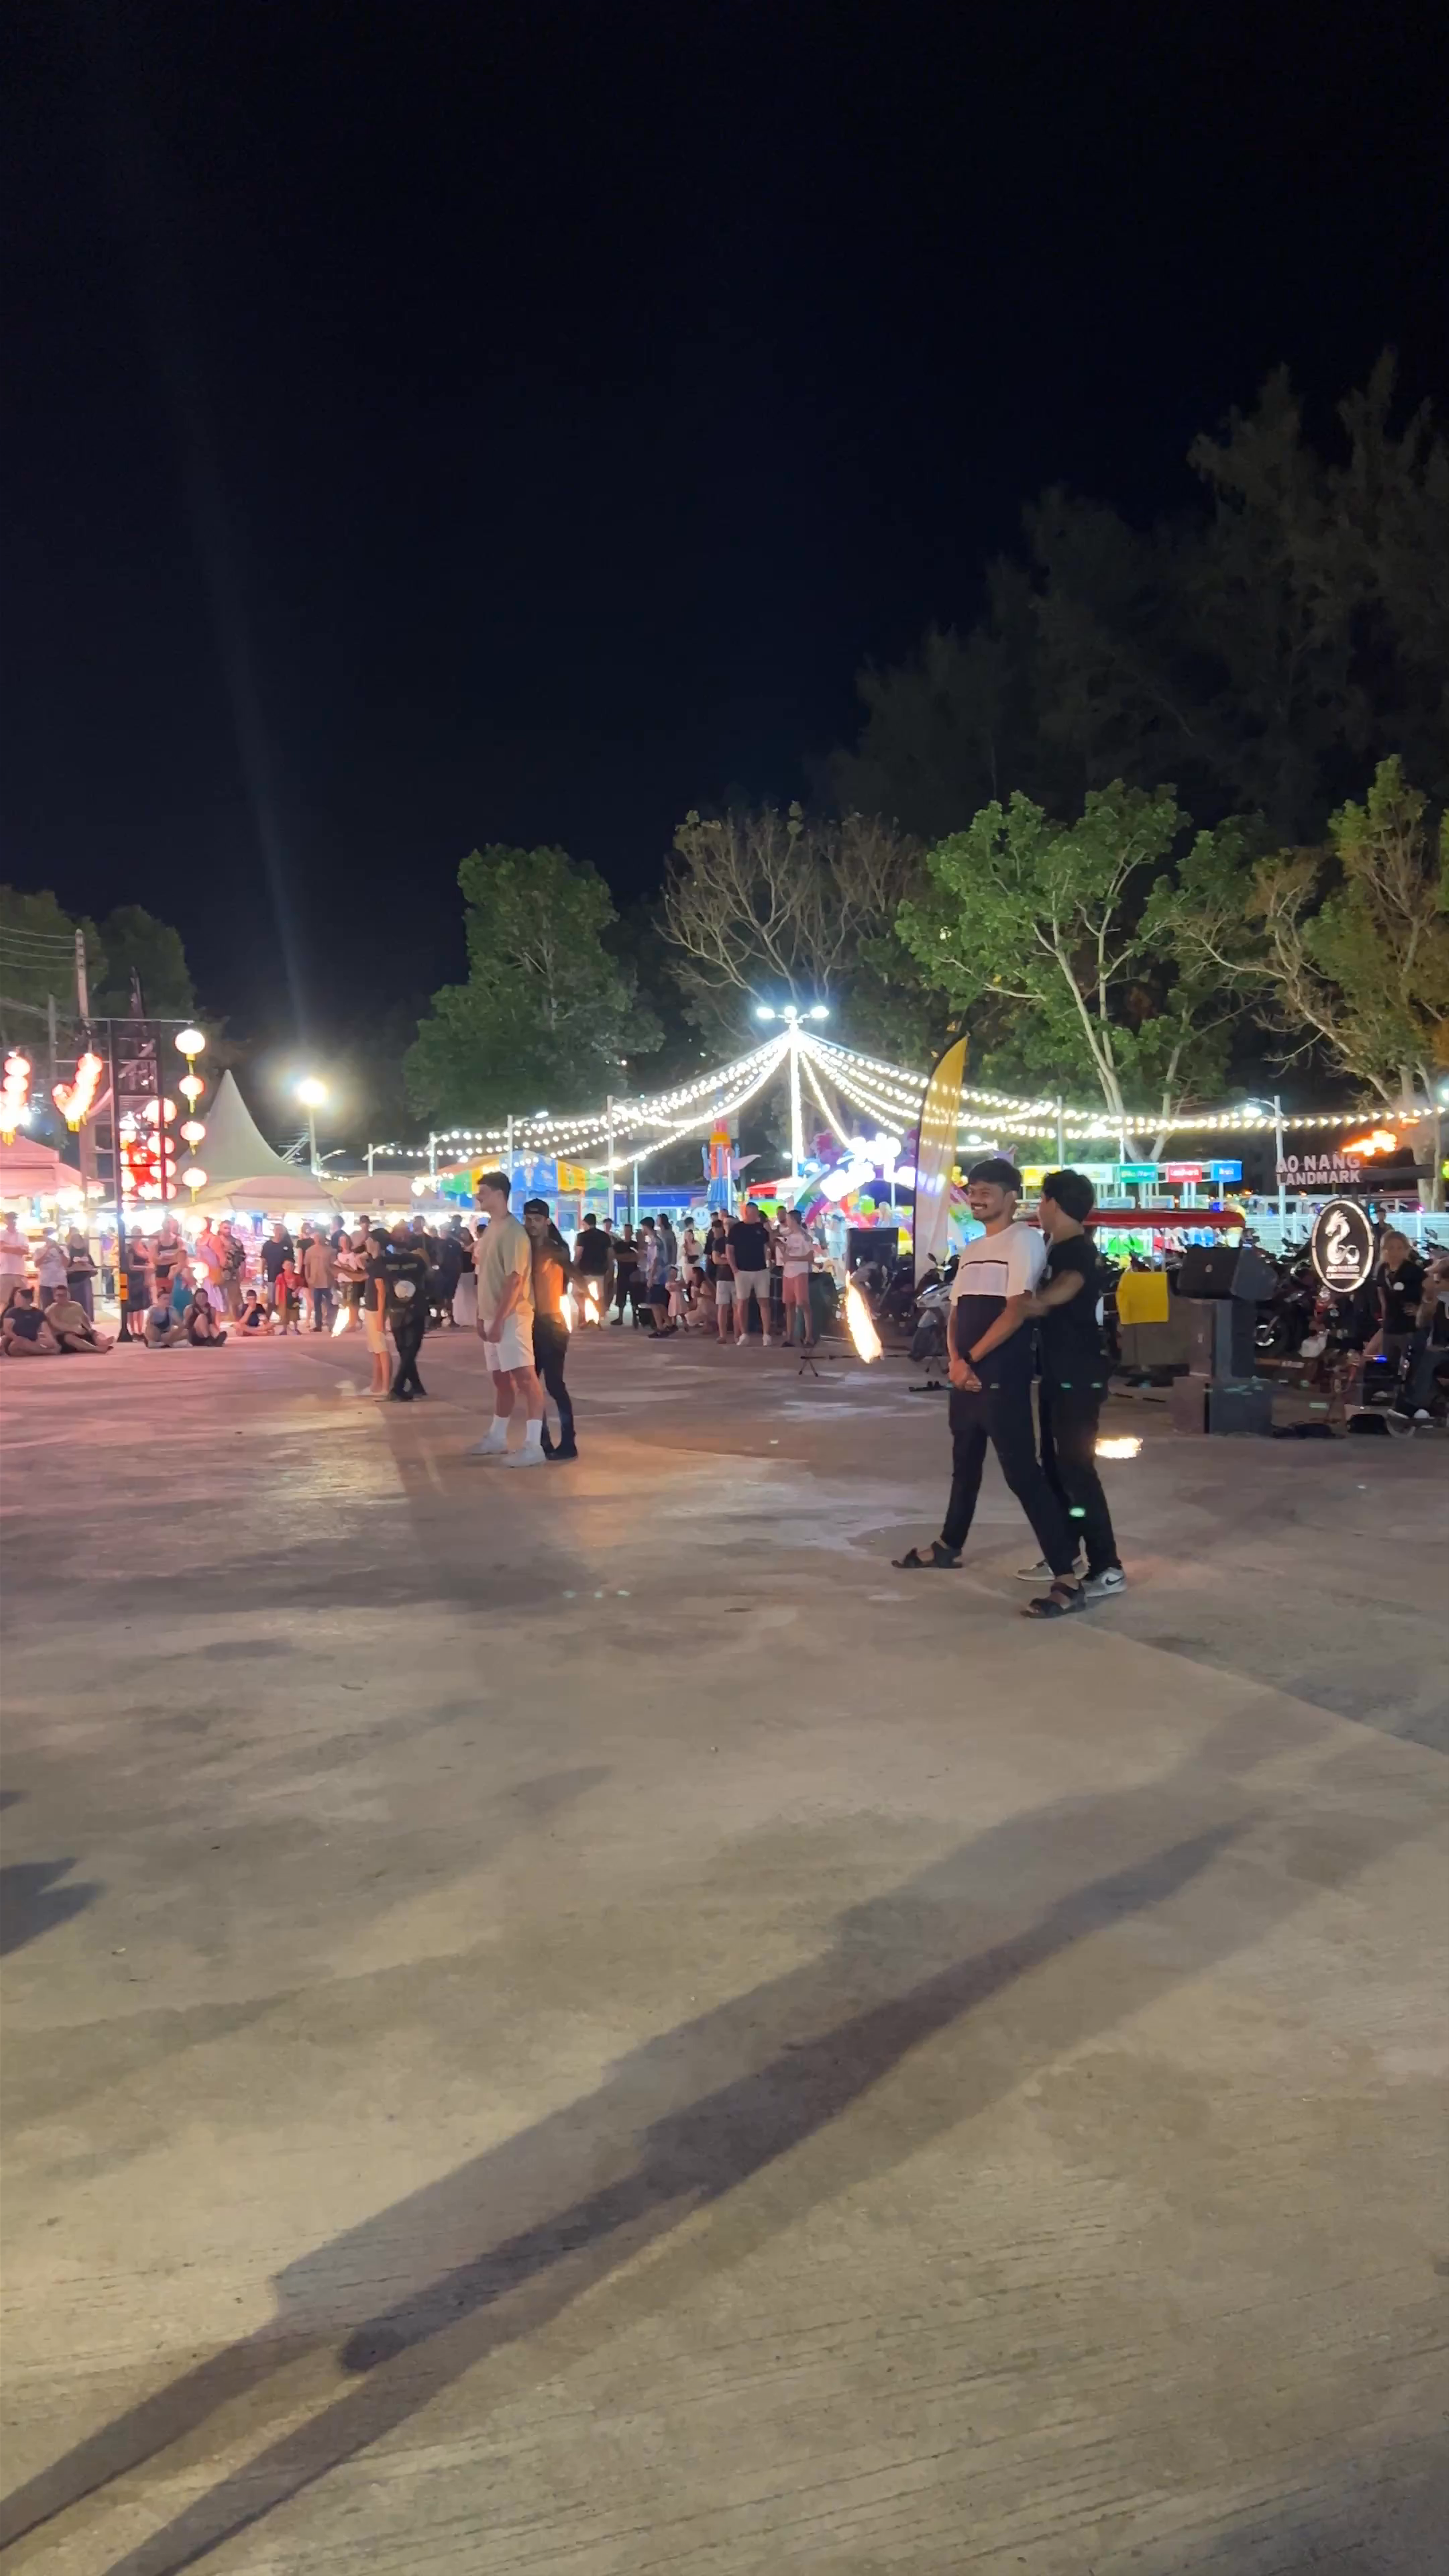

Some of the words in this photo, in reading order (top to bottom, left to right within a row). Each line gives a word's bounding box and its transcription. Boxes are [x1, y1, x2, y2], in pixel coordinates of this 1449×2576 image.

[1276, 1155, 1299, 1173] AO
[1304, 1152, 1360, 1171] NANG
[1277, 1170, 1360, 1186] LANDMARK
